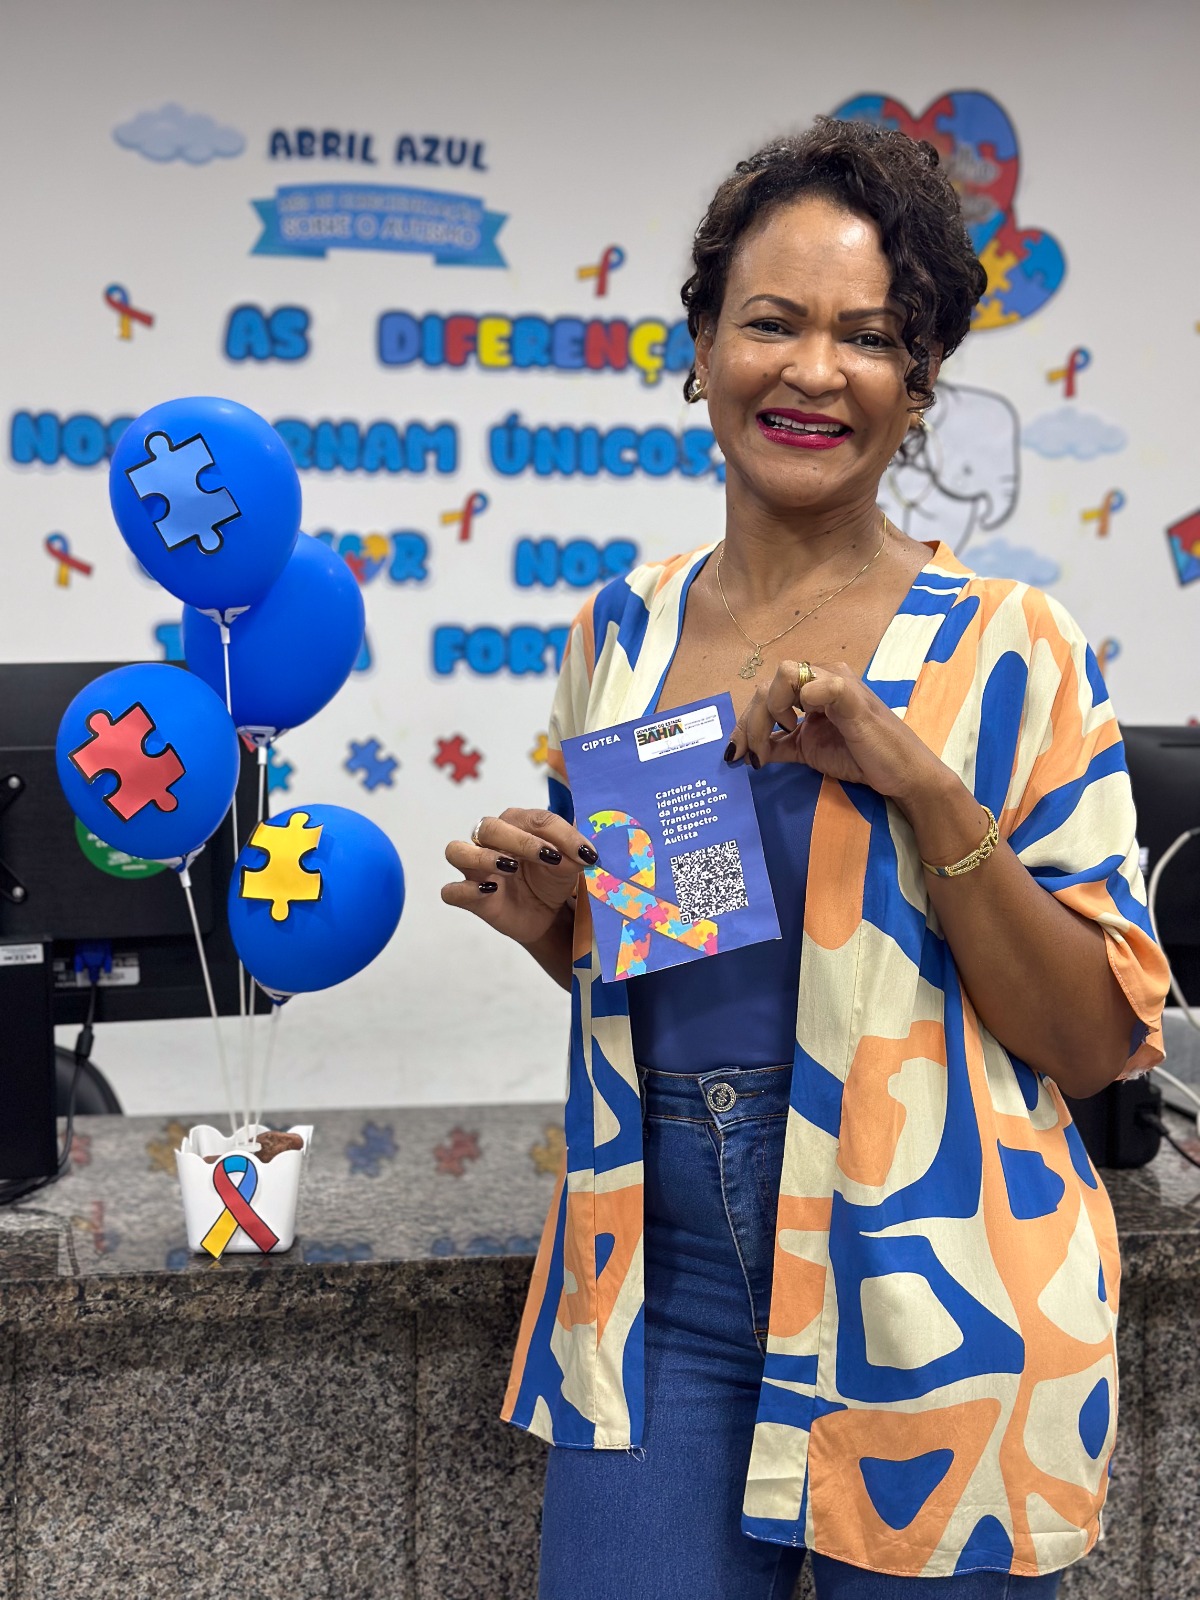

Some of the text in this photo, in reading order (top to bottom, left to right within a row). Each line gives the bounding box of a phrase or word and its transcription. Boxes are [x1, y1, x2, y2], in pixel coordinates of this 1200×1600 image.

[269, 129, 488, 171] ABRIL AZUL
[224, 304, 695, 386] AS DIFERENÇA
[581, 733, 621, 752] CIPTEA
[636, 722, 684, 747] BAHIA
[655, 779, 707, 800] Carteira de
[657, 786, 718, 809] Identificação
[658, 793, 728, 818] da Pessoa com
[660, 807, 712, 827] Transtorno
[662, 815, 718, 837] do Espectro
[664, 831, 699, 846] Autista
